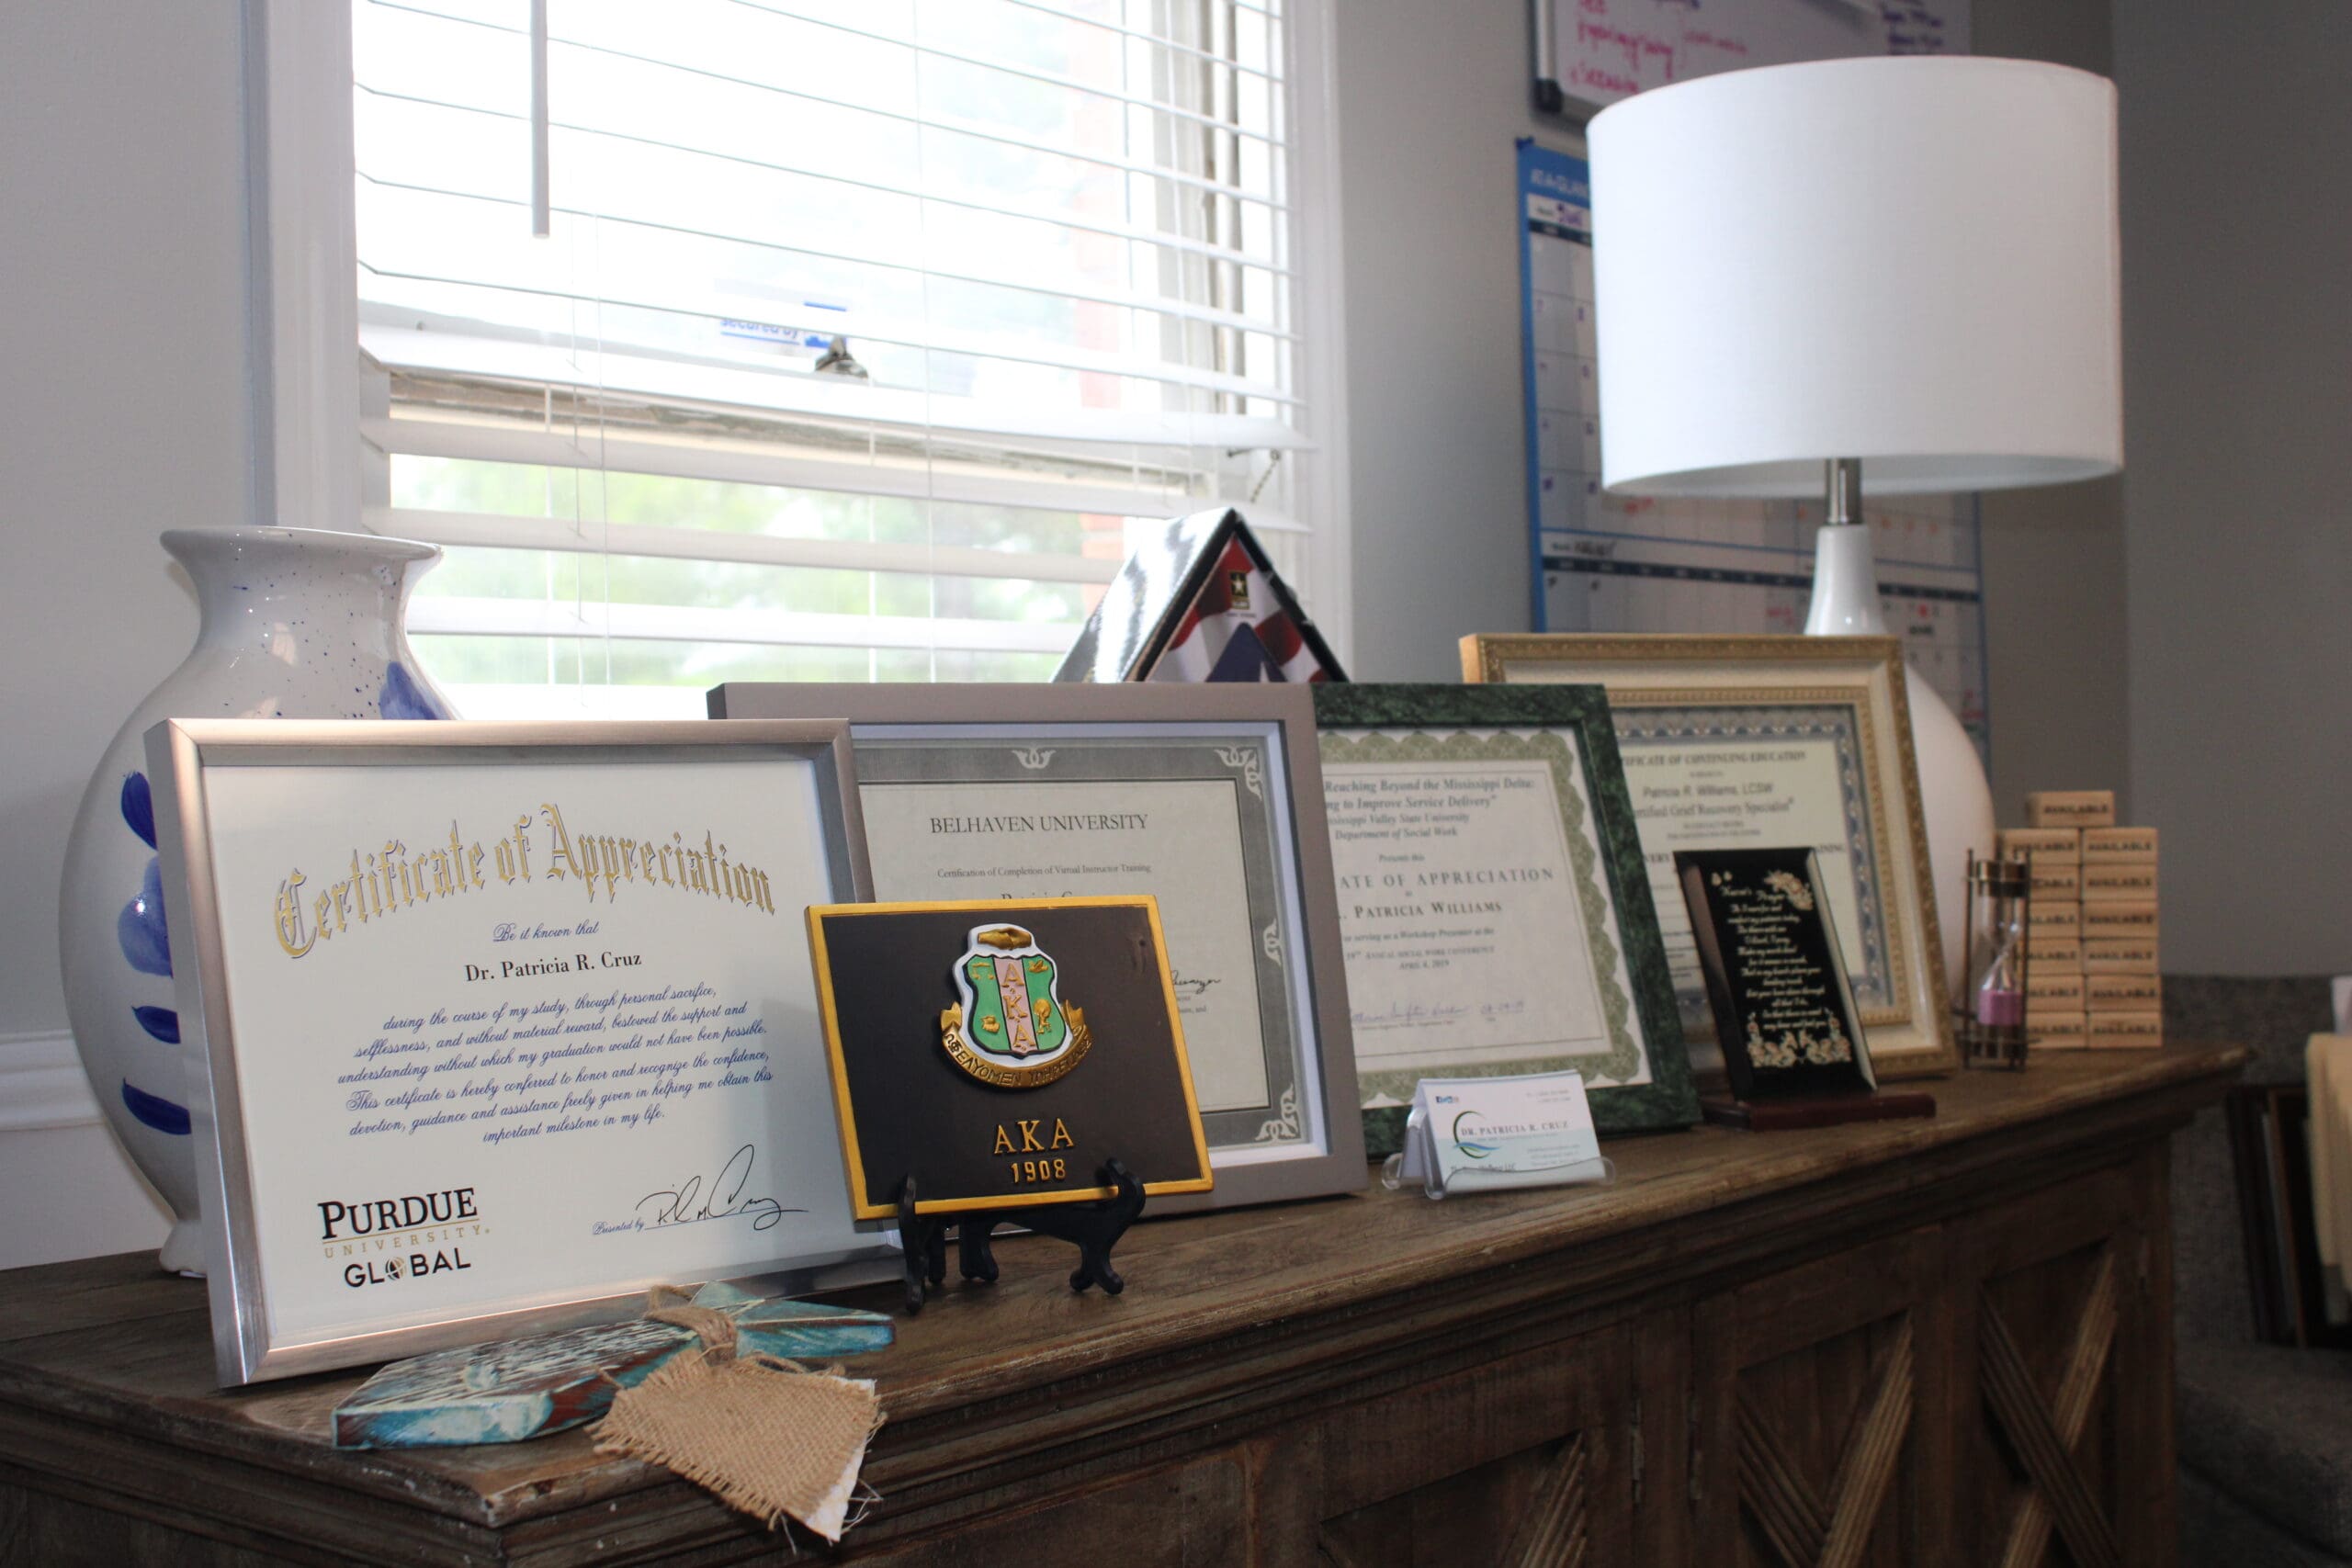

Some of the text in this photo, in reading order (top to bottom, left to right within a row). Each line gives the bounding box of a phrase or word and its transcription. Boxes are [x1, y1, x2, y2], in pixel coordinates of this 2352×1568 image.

[1424, 779, 1439, 790] the
[1443, 778, 1500, 792] Mississippi
[1357, 796, 1402, 810] Improve
[1406, 796, 1443, 808] Service
[930, 813, 1148, 834] BELHAVEN UNIVERSITY
[1335, 827, 1458, 840] Department of Social Work
[275, 803, 775, 959] Certificate of Appreciation
[936, 863, 1151, 879] Certification of Completion of Virtual Instructor Training
[1384, 874, 1406, 887] OF
[1417, 867, 1554, 886] APPRECIATION
[1354, 901, 1502, 919] PATRICIA WILLIAMS
[492, 920, 600, 943] Be it known that
[465, 949, 643, 983] Dr. Patricia R. Cruz
[383, 981, 717, 1034] during the course of my study, through personal sacrifice,
[353, 1001, 748, 1062] selflessness, and without material reward, bestowed the support and
[337, 1018, 768, 1084] understanding without which my graduation would not have been possible.
[345, 1047, 770, 1111] This certificate is hereby conferred to honor and recognize the confidence,
[349, 1066, 774, 1137] devotion, guidance and assistance freely given in helping me obtain this
[482, 1103, 665, 1145] important milestone in my life.
[994, 1118, 1075, 1155] AKA
[1462, 1122, 1568, 1136] DR. PATRICIA R. CRUZ
[1011, 1158, 1067, 1183] 1908
[318, 1187, 478, 1240] PURDUE
[593, 1220, 645, 1235] Presented by
[324, 1224, 483, 1258] UNIVERSITY
[344, 1247, 471, 1288] GLOBAL
